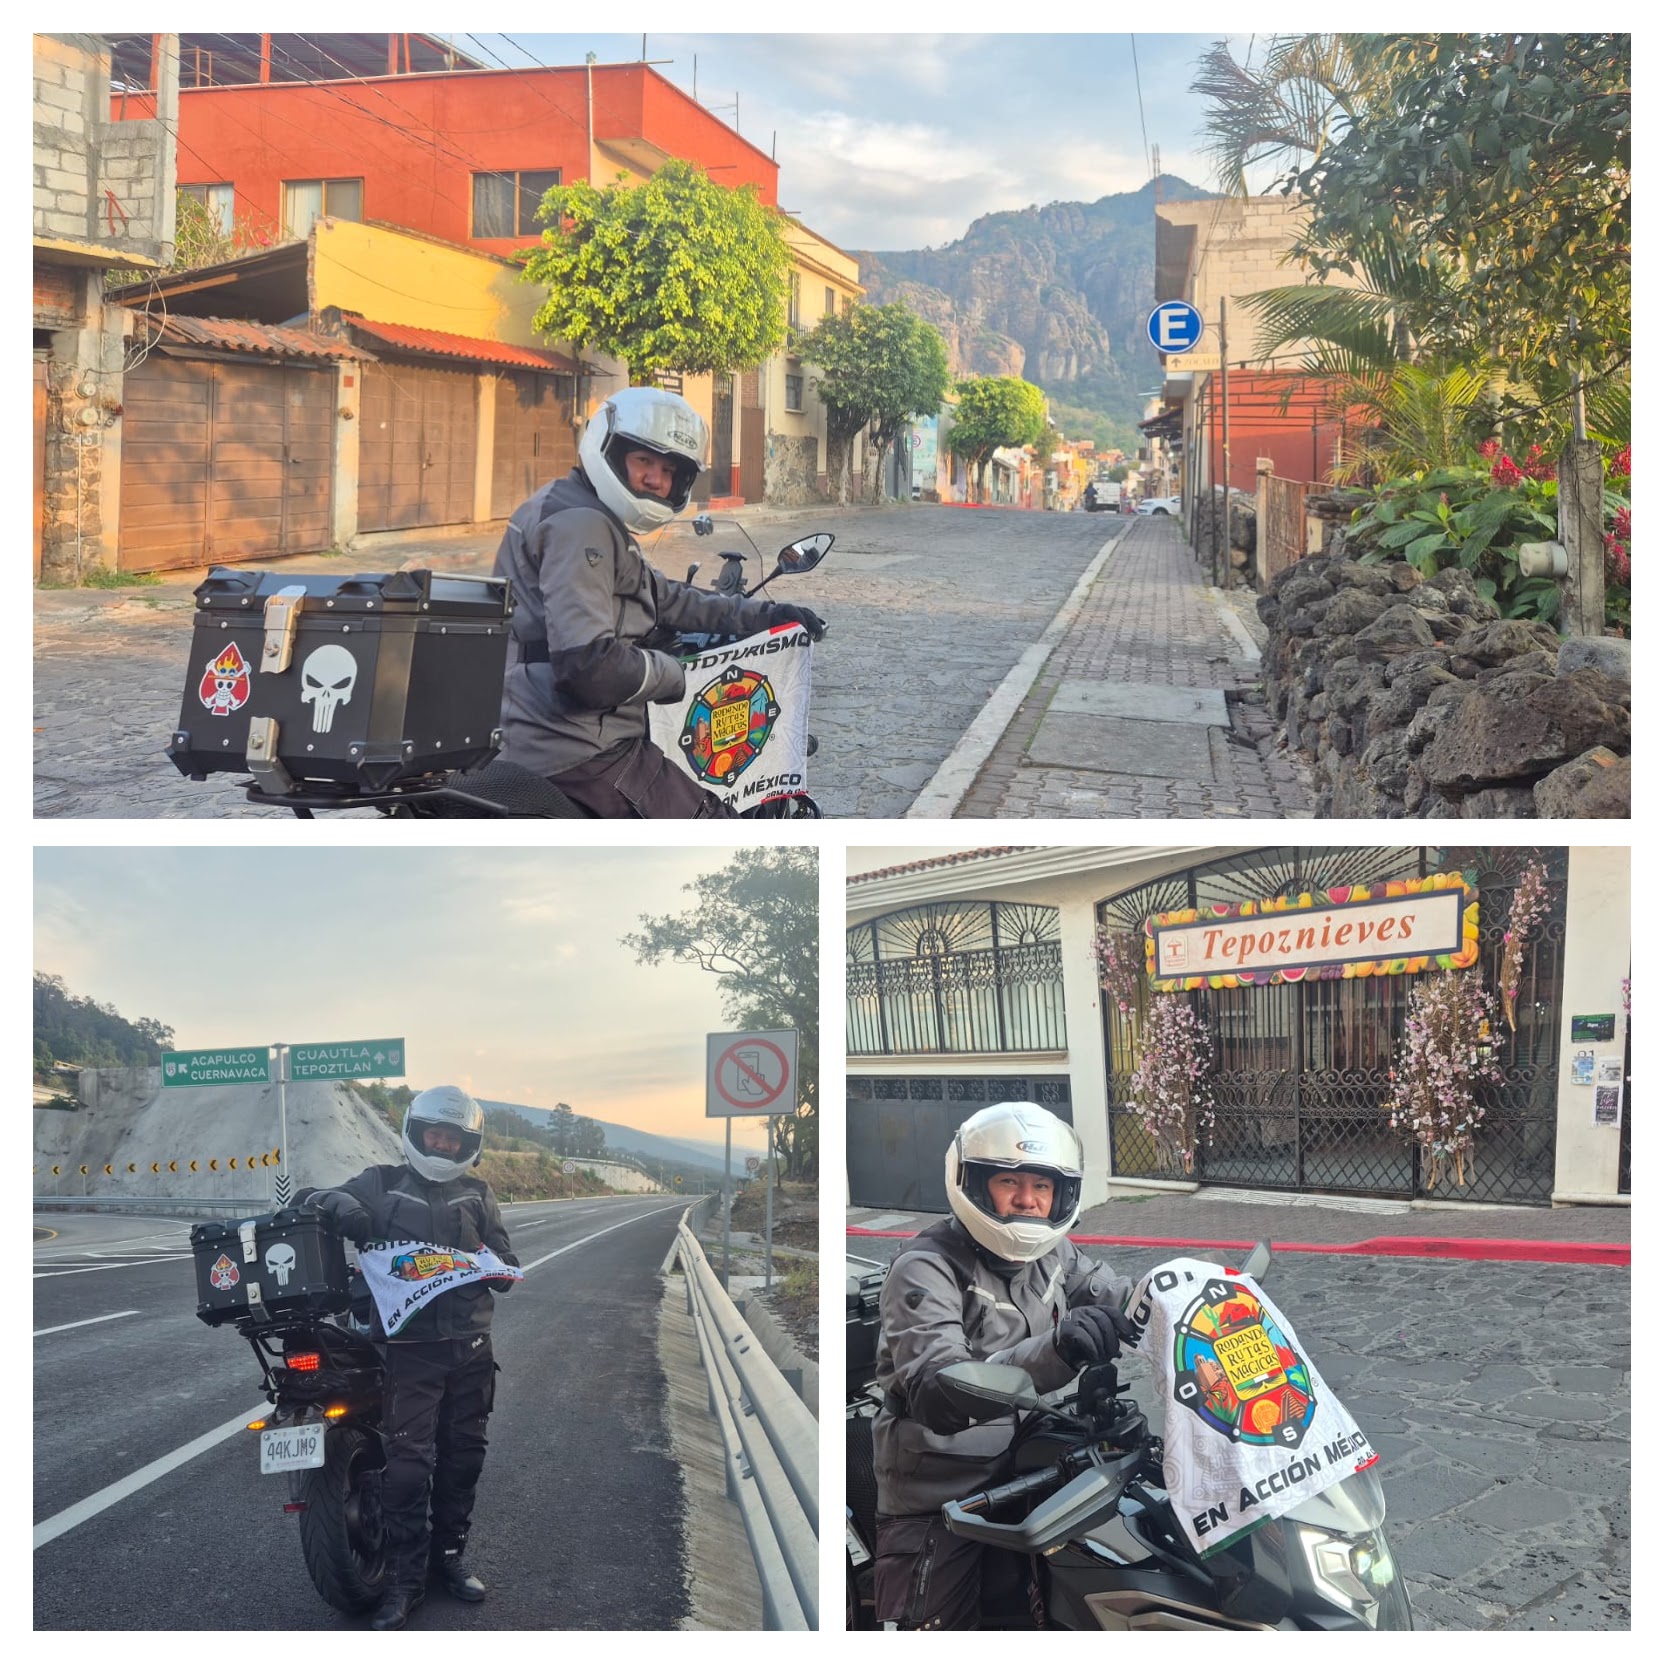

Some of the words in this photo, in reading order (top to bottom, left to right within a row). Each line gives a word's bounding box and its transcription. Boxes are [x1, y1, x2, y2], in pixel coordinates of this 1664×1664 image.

[1159, 308, 1189, 346] E
[726, 669, 739, 680] N
[768, 707, 777, 716] E
[727, 772, 735, 782] S
[743, 774, 802, 798] MÉXICO
[1203, 914, 1416, 967] Tepoznieves
[191, 1053, 256, 1066] ACAPULCO
[297, 1047, 370, 1060] CUAUTLA
[191, 1068, 266, 1080] CUERNAVACA
[294, 1062, 371, 1075] TEPOZTLAN
[1209, 1283, 1227, 1299] N
[387, 1308, 401, 1329] EN
[404, 1276, 453, 1309] ACCIÓN
[1179, 1382, 1197, 1399] O
[1282, 1426, 1298, 1441] S
[267, 1437, 316, 1460] 44KJM9
[1193, 1502, 1229, 1537] EN
[1239, 1453, 1321, 1512] ACCIÓN
